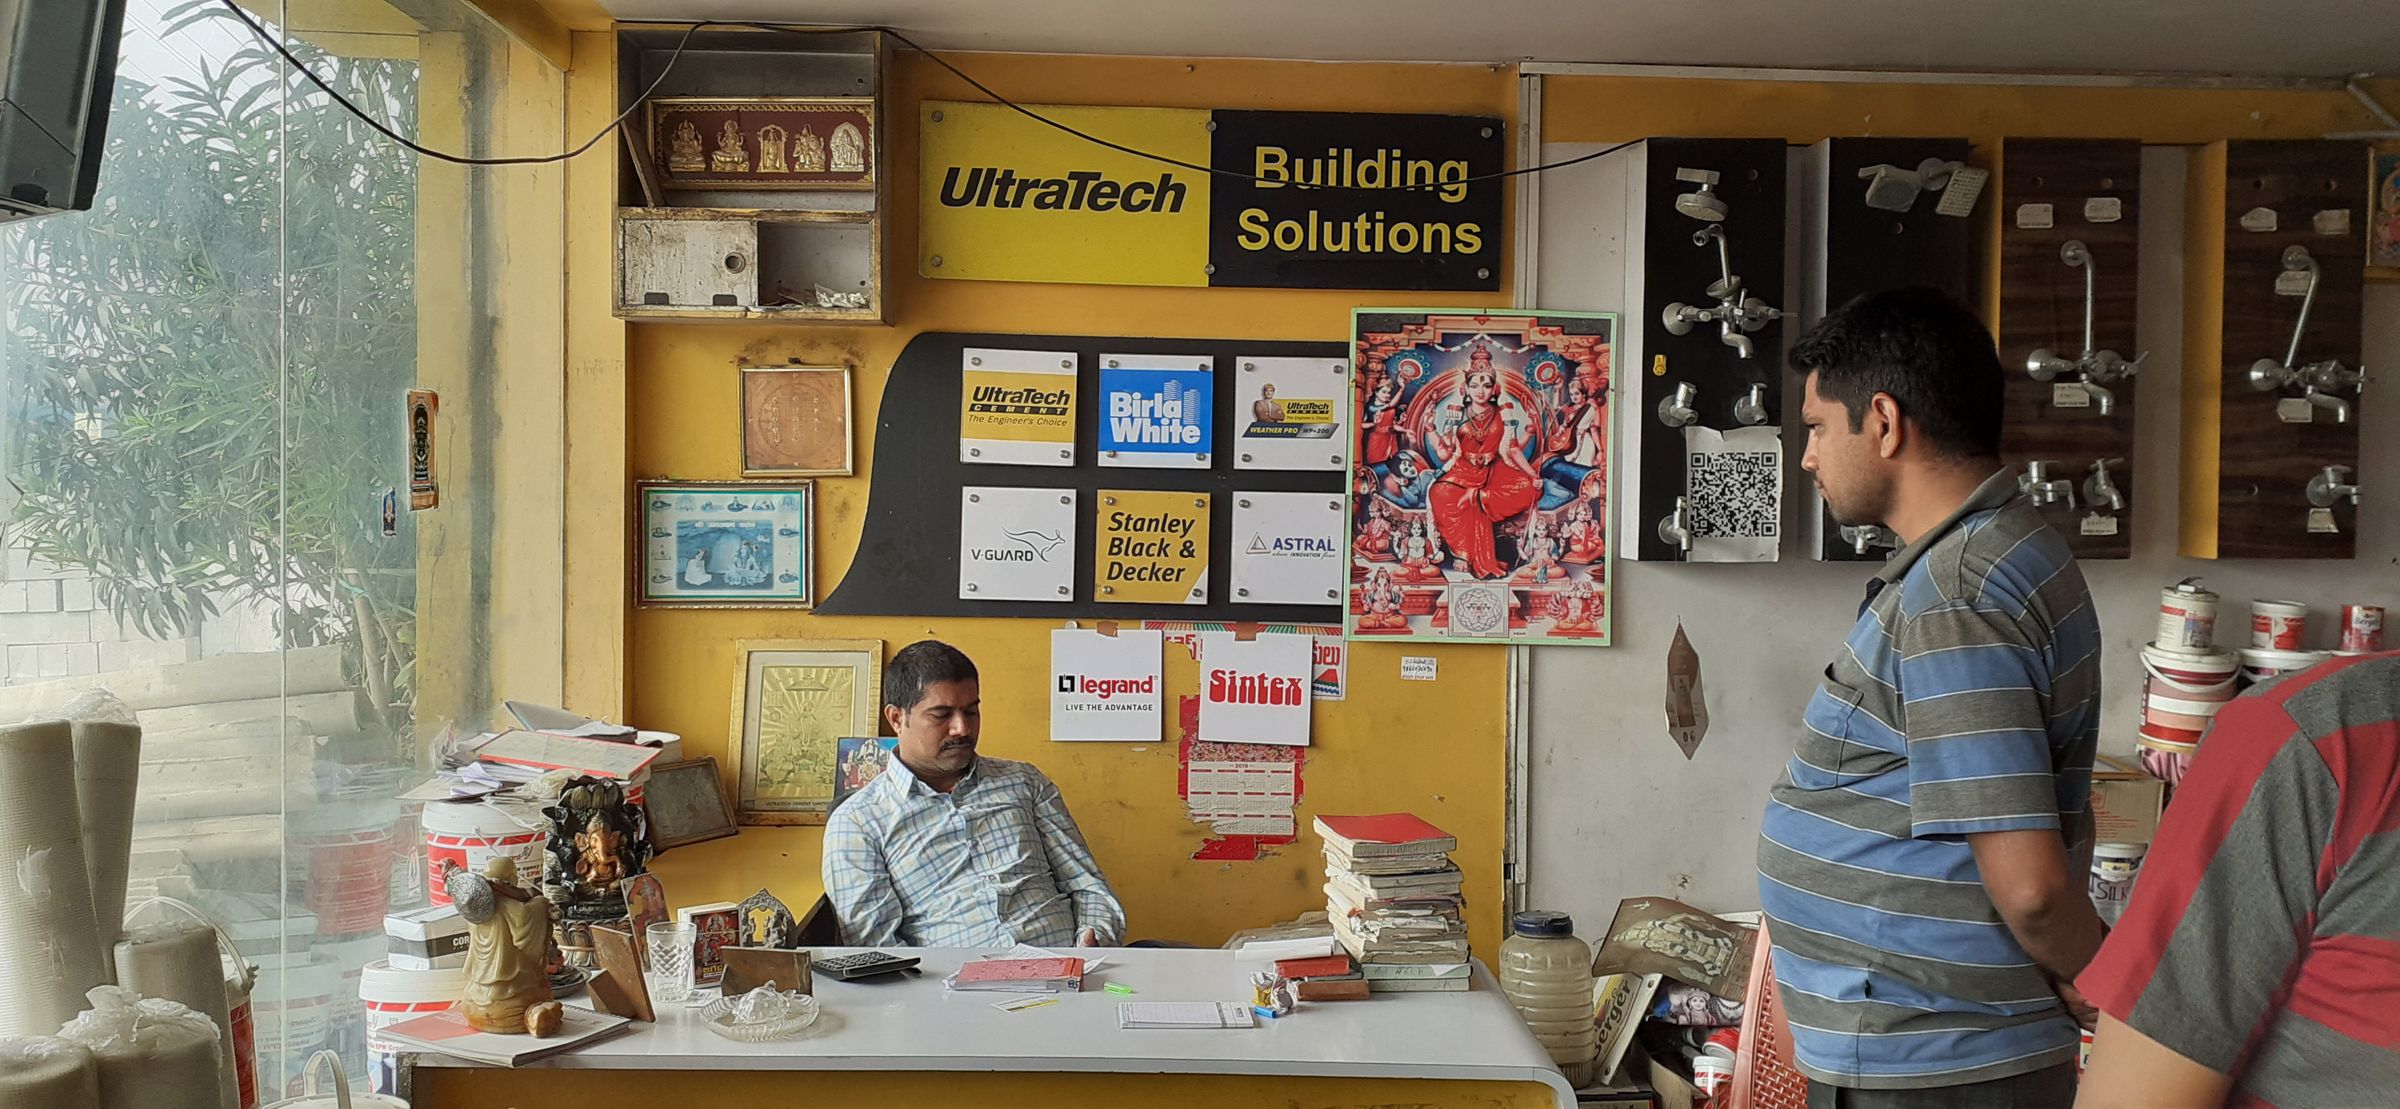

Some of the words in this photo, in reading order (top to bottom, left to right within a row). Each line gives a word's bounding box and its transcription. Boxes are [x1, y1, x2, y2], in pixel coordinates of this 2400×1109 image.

[1255, 147, 1469, 203] Building
[940, 167, 1187, 213] UltraTech
[1237, 208, 1482, 254] Solutions
[973, 386, 1070, 405] UltraTech
[1110, 392, 1182, 418] Birla
[1287, 402, 1329, 410] UltraTech
[969, 414, 984, 423] The
[988, 416, 1033, 425] Engineer's
[1037, 417, 1068, 427] Choice
[973, 405, 1063, 415] CEMENT
[1110, 417, 1201, 445] White
[1108, 512, 1195, 538] Stanley
[1108, 537, 1170, 558] Black
[1179, 540, 1196, 558] &
[1273, 536, 1336, 552] ASTRAL
[1107, 562, 1186, 582] Decker
[1080, 675, 1153, 699] legrand
[1209, 669, 1303, 706] Sintex
[2095, 881, 2127, 901] SILK
[452, 935, 470, 947] COR
